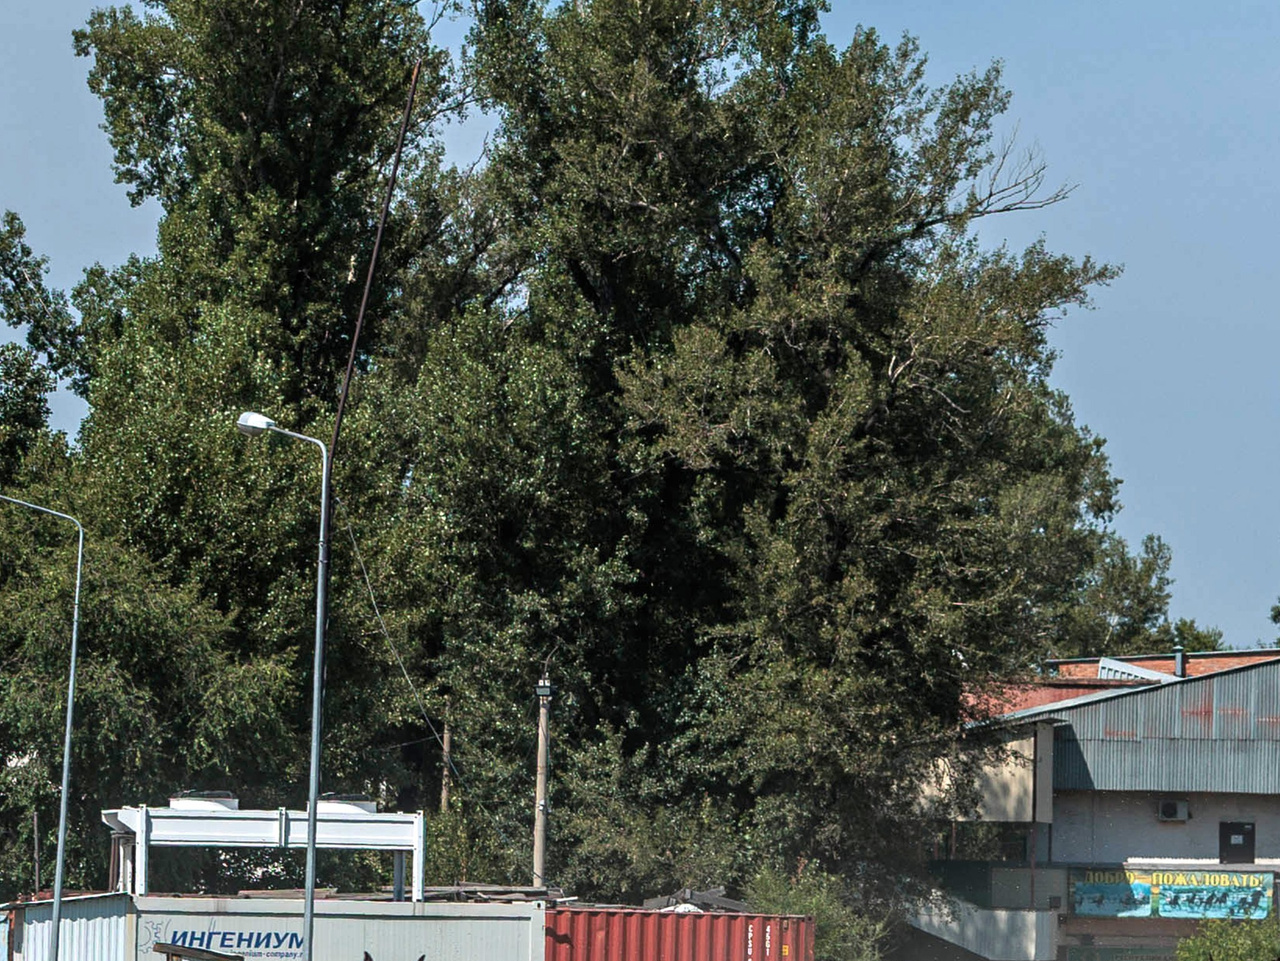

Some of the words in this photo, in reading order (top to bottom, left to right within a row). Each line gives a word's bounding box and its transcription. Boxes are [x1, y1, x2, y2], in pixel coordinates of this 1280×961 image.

[1085, 870, 1135, 884] ДОБРО
[1152, 872, 1264, 886] ПОЖАЛОВАТЬ!
[171, 930, 303, 949] ИНГЕНИУМ
